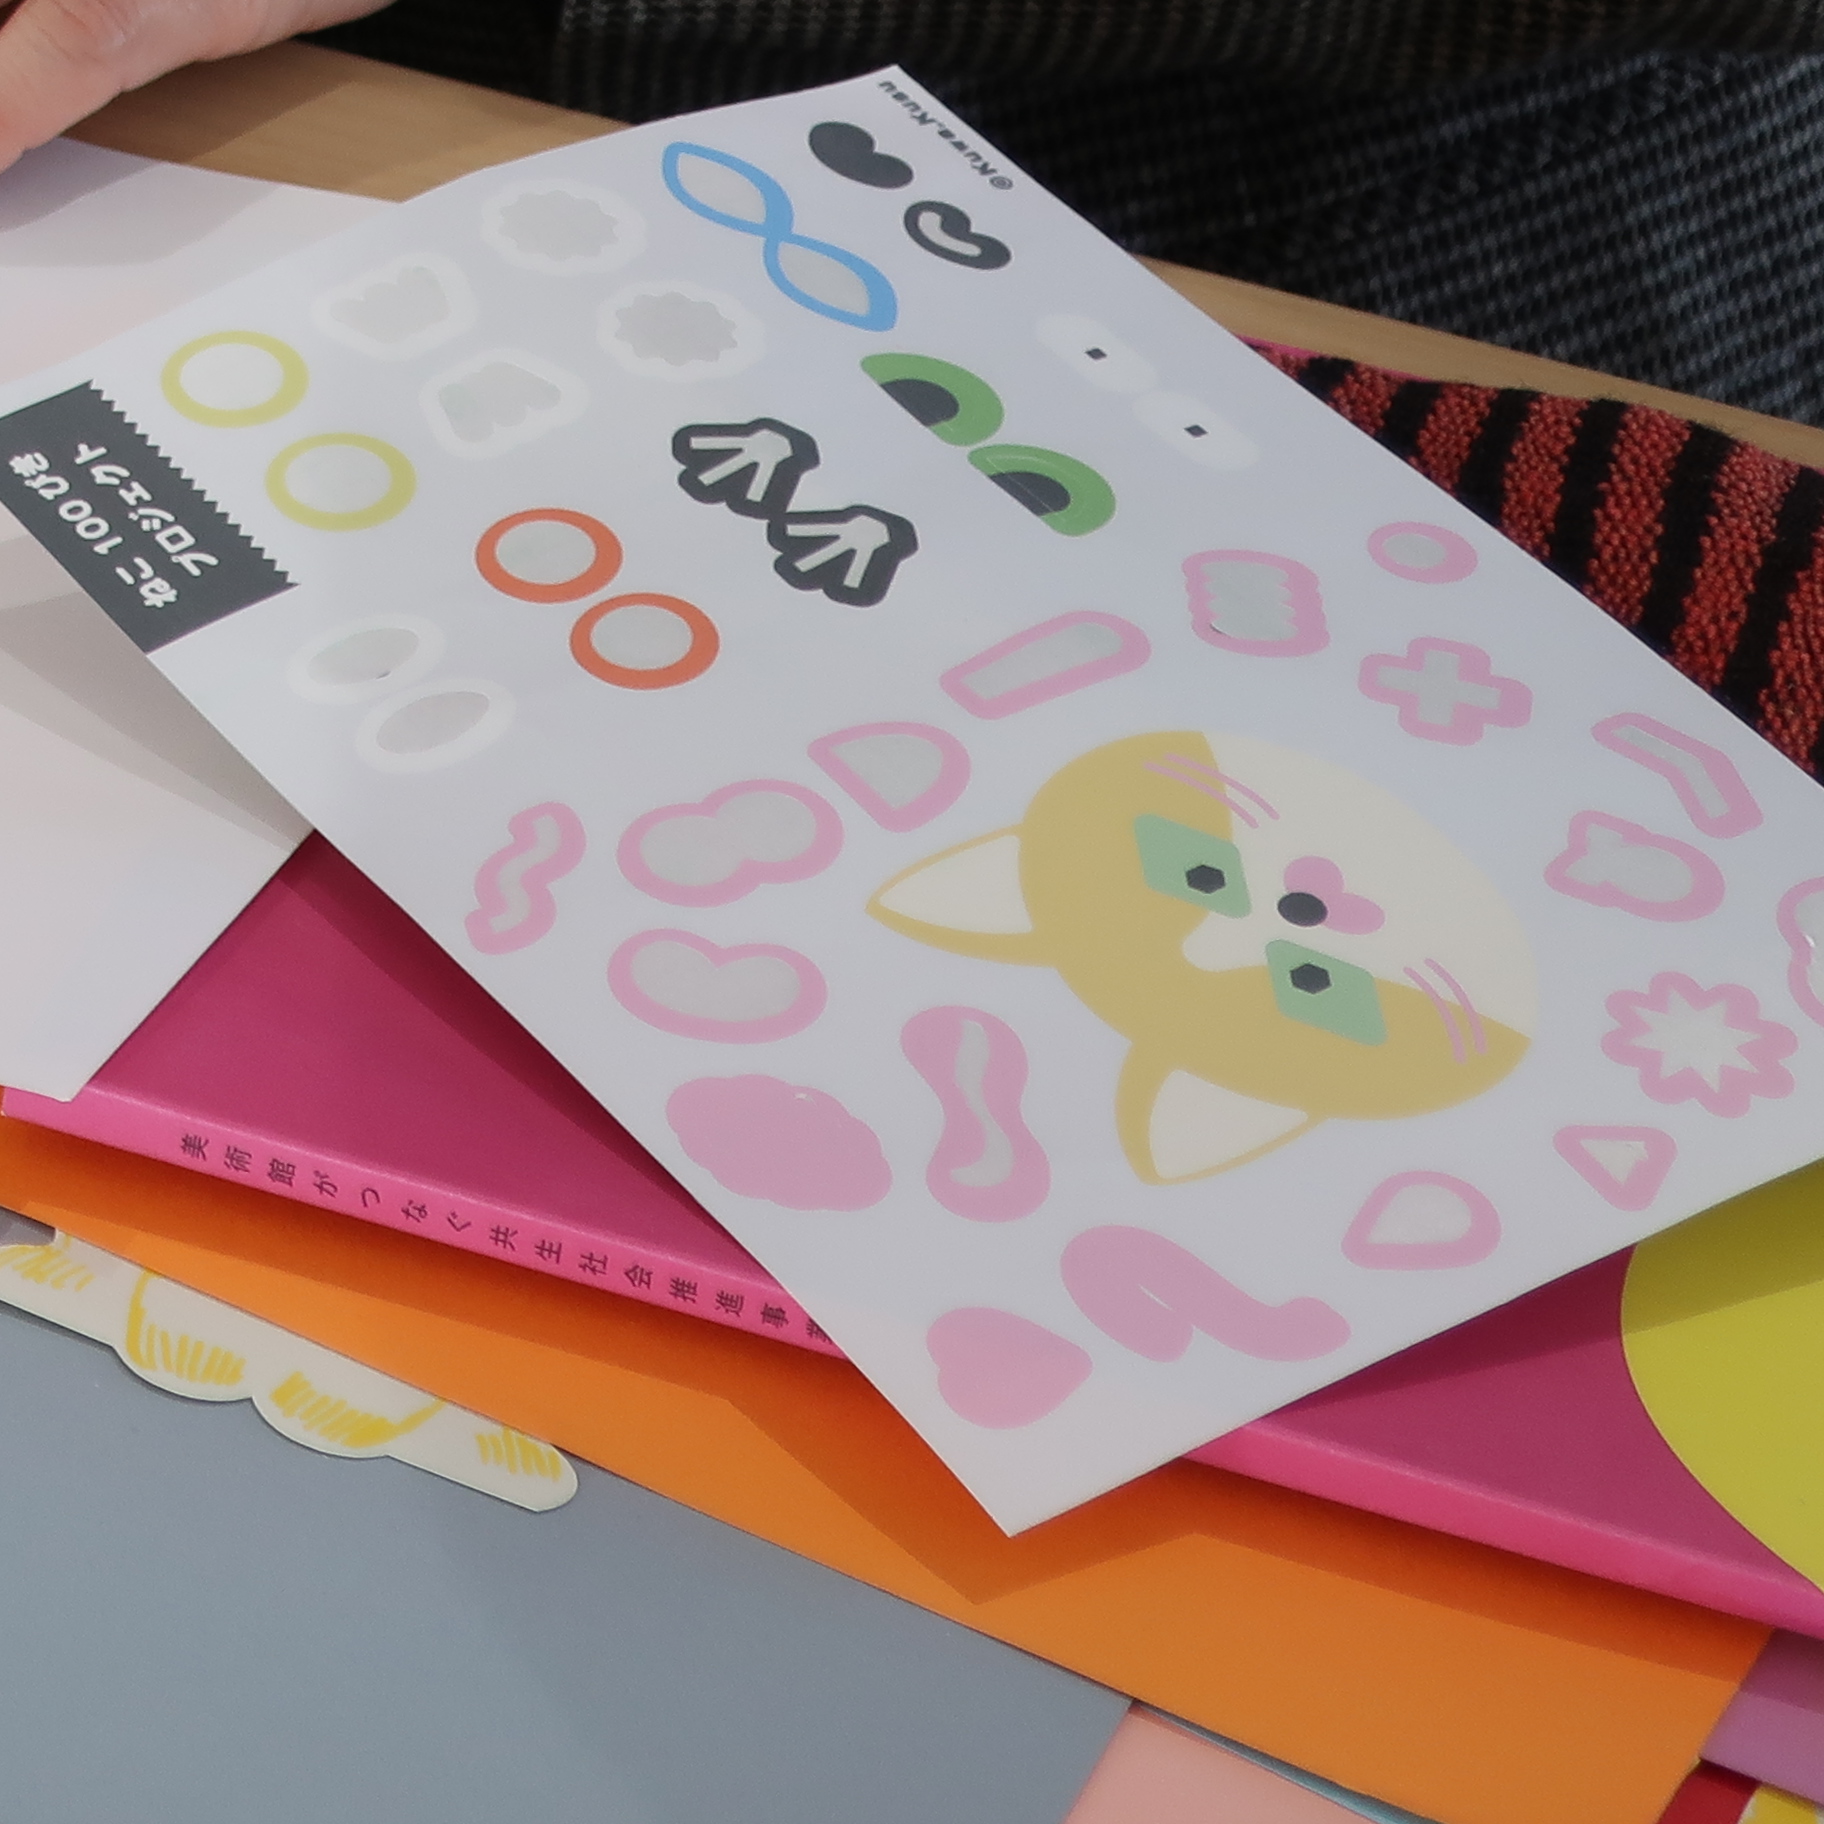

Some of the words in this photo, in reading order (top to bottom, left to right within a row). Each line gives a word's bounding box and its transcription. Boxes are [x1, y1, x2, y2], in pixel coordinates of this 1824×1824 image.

[75, 442, 219, 577] プロジェクト
